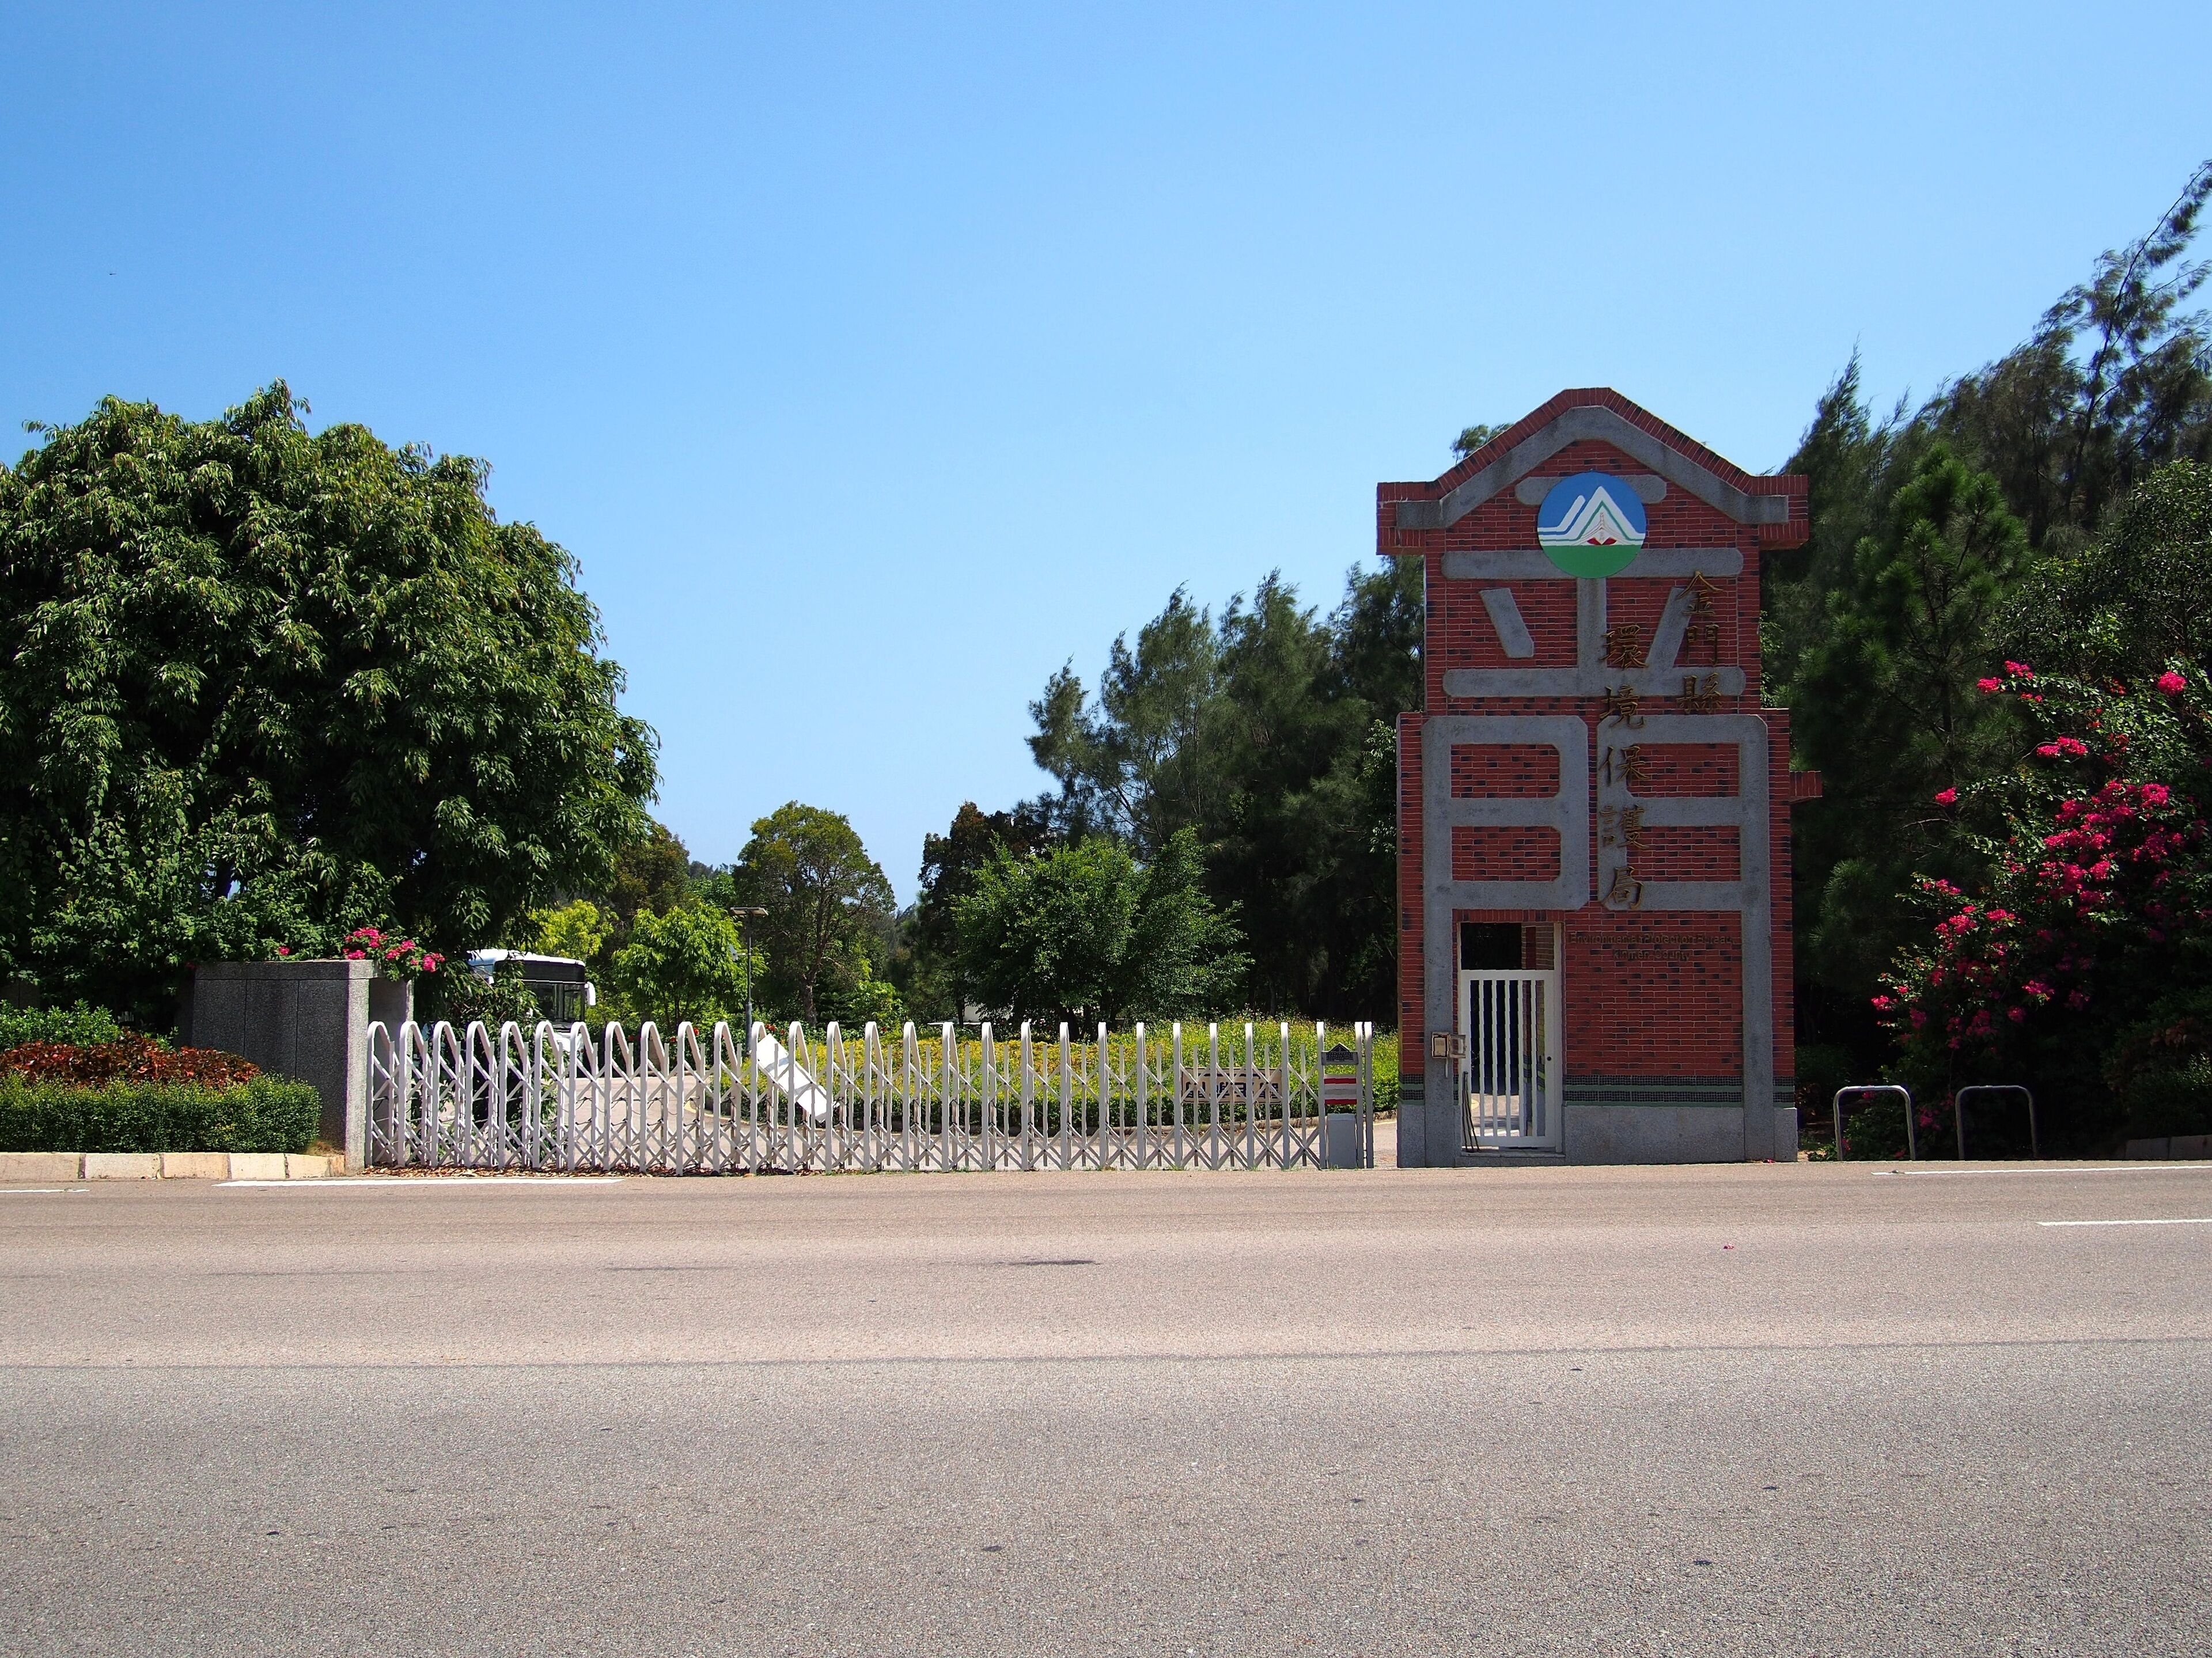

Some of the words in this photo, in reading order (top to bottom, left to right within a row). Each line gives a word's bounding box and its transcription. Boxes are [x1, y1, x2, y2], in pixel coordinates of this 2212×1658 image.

[1675, 570, 1724, 714] 金門縣
[1598, 623, 1651, 910] 環境保護局
[1643, 932, 1694, 944] Protection
[1654, 948, 1690, 961] County
